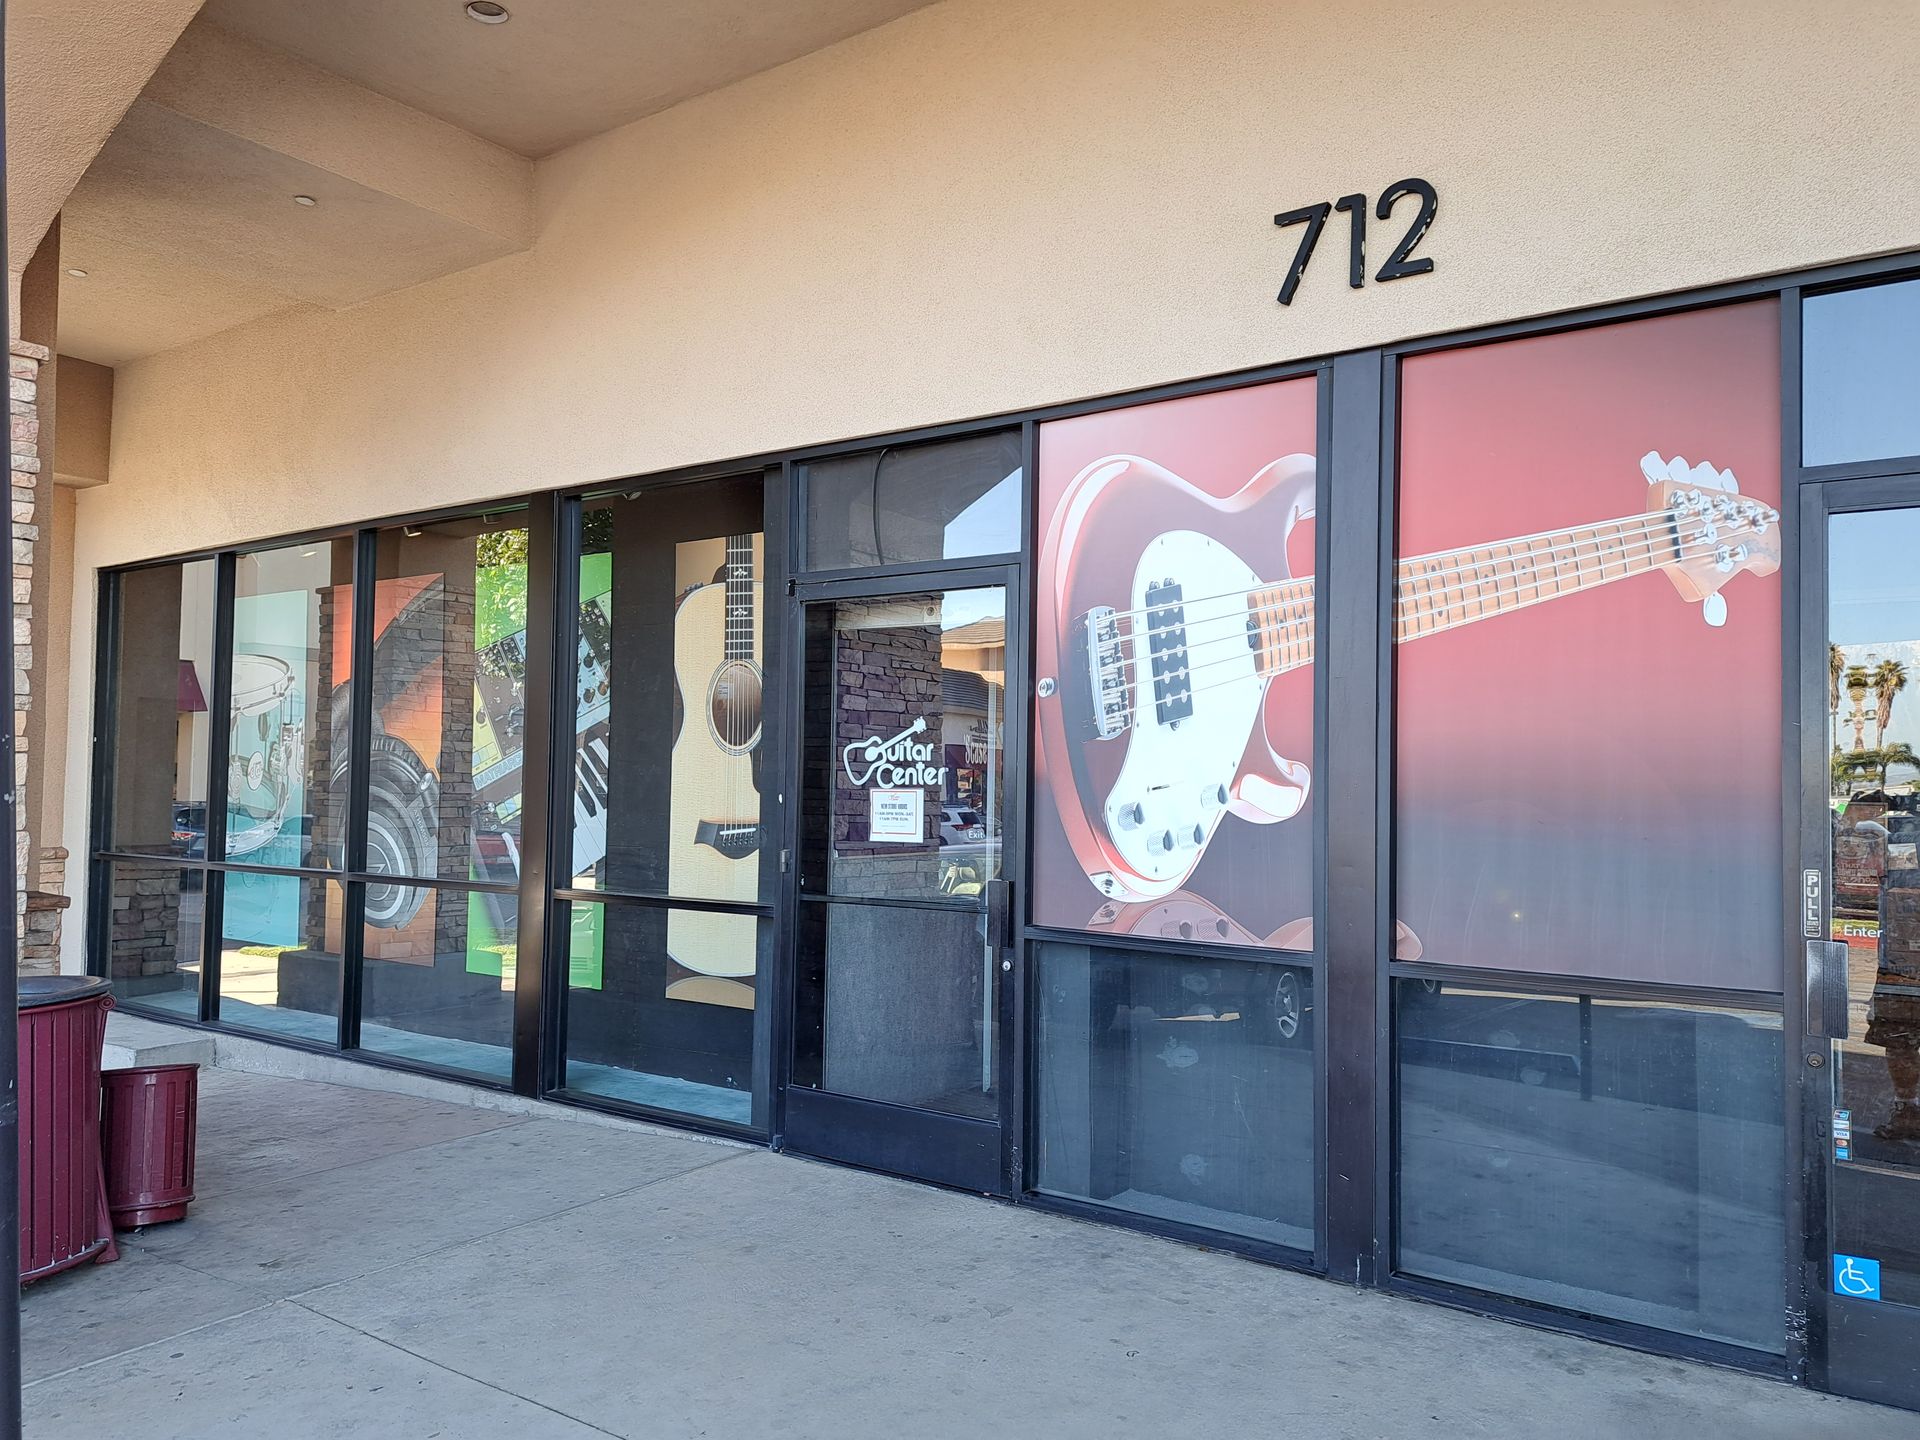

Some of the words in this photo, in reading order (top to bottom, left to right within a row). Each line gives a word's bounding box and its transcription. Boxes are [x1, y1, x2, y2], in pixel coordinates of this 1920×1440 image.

[1274, 178, 1438, 306] 712
[877, 762, 949, 789] Center
[1806, 875, 1819, 920] PULL
[1844, 925, 1883, 938] Enter
